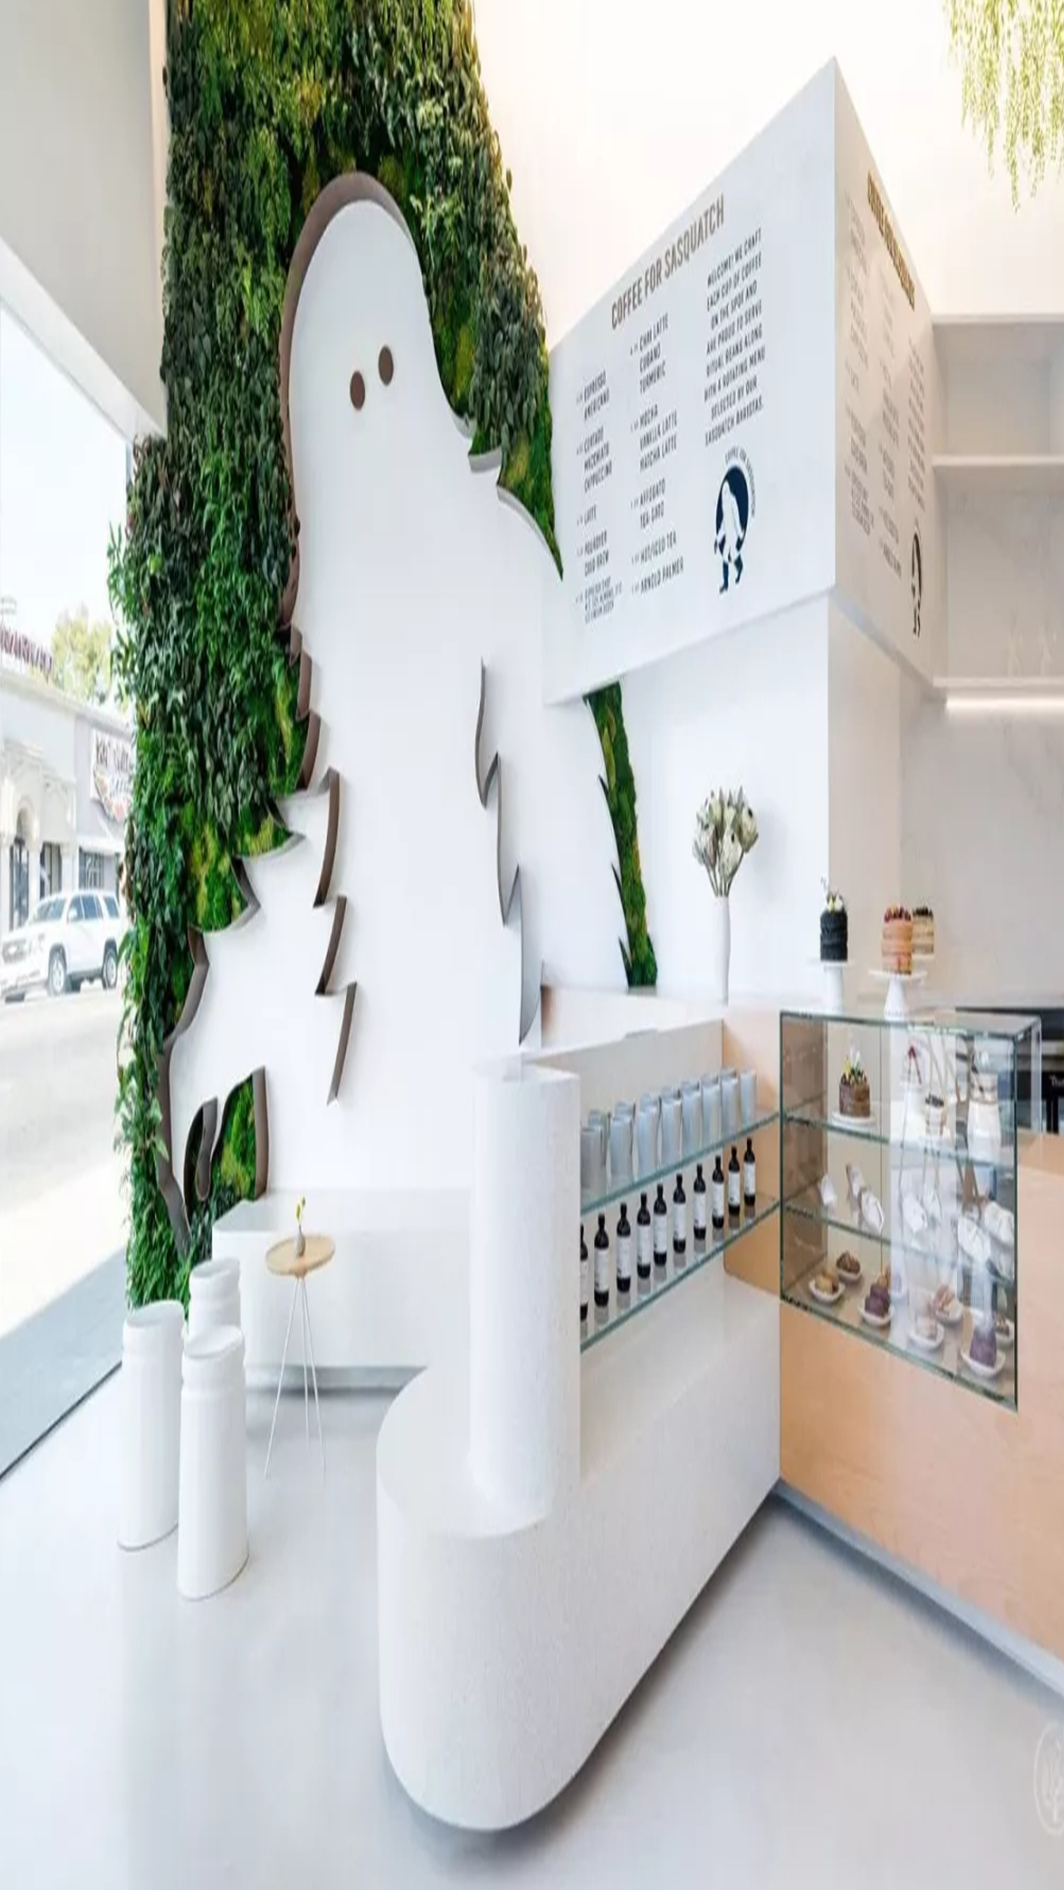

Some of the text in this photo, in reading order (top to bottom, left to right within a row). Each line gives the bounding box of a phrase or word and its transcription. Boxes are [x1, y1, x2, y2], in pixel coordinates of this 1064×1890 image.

[612, 193, 724, 330] COFFEE FOR SASQUATCH
[722, 277, 732, 298] CUP
[733, 270, 740, 288] OF
[742, 251, 761, 282] COFFEE
[711, 314, 718, 330] ON
[720, 302, 729, 322] THE
[746, 279, 757, 301] AND
[737, 315, 743, 332] TO
[745, 299, 762, 325] SERVE
[653, 312, 668, 340] LATTE
[726, 338, 742, 364] BEANS
[744, 323, 762, 348] ALONG
[749, 346, 765, 368] MENU
[712, 374, 757, 421] SELECTED BY OUR
[662, 410, 677, 435] LATTE
[705, 416, 734, 447] SASQUATCH
[662, 434, 677, 458] LATTE
[584, 504, 596, 525] LATTE
[667, 530, 676, 549] TEA
[641, 569, 661, 594] ARNOLD
[662, 556, 684, 582] PALMER
